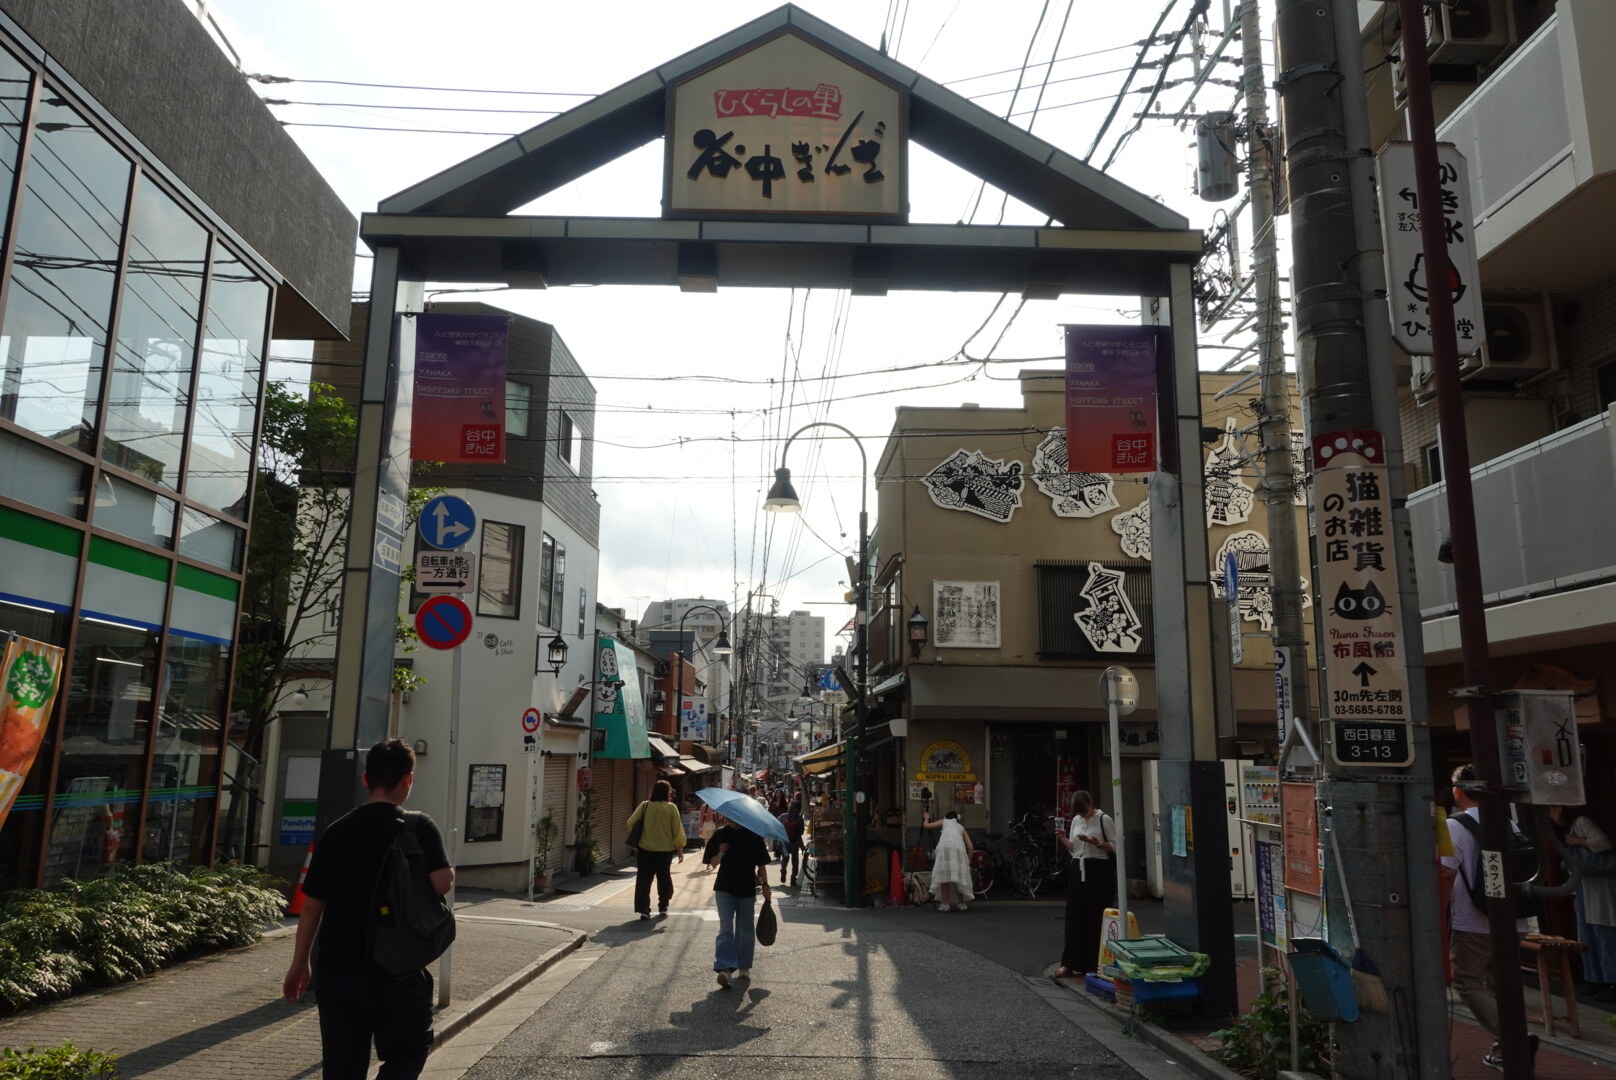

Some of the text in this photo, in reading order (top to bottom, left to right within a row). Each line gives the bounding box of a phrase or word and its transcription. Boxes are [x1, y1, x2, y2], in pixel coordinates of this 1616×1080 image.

[717, 84, 842, 119] ひぐらしの里
[687, 111, 887, 199] 谷中ぎんざ
[420, 351, 448, 359] TOKYO
[1069, 362, 1096, 370] TOKYO
[418, 369, 453, 377] YANAKA
[417, 386, 494, 396] SHOPPING STREET
[1069, 396, 1145, 405] SHOPPING STREET
[466, 430, 496, 441] 谷中
[465, 443, 496, 454] ぎんざ
[1116, 439, 1148, 451] 谷中
[1116, 452, 1148, 465] ぎんざ
[1323, 493, 1349, 562] のお店
[1346, 472, 1387, 572] 猫雑貨
[421, 556, 470, 567] 自転車を除く
[421, 568, 470, 579] 一方通行
[1329, 626, 1396, 640] Nuno Fusen
[1334, 689, 1402, 702] 30m先左側
[1335, 705, 1403, 715] 03-5685-6788
[1344, 729, 1397, 741] 西日暮里
[1351, 745, 1392, 758] 3-13
